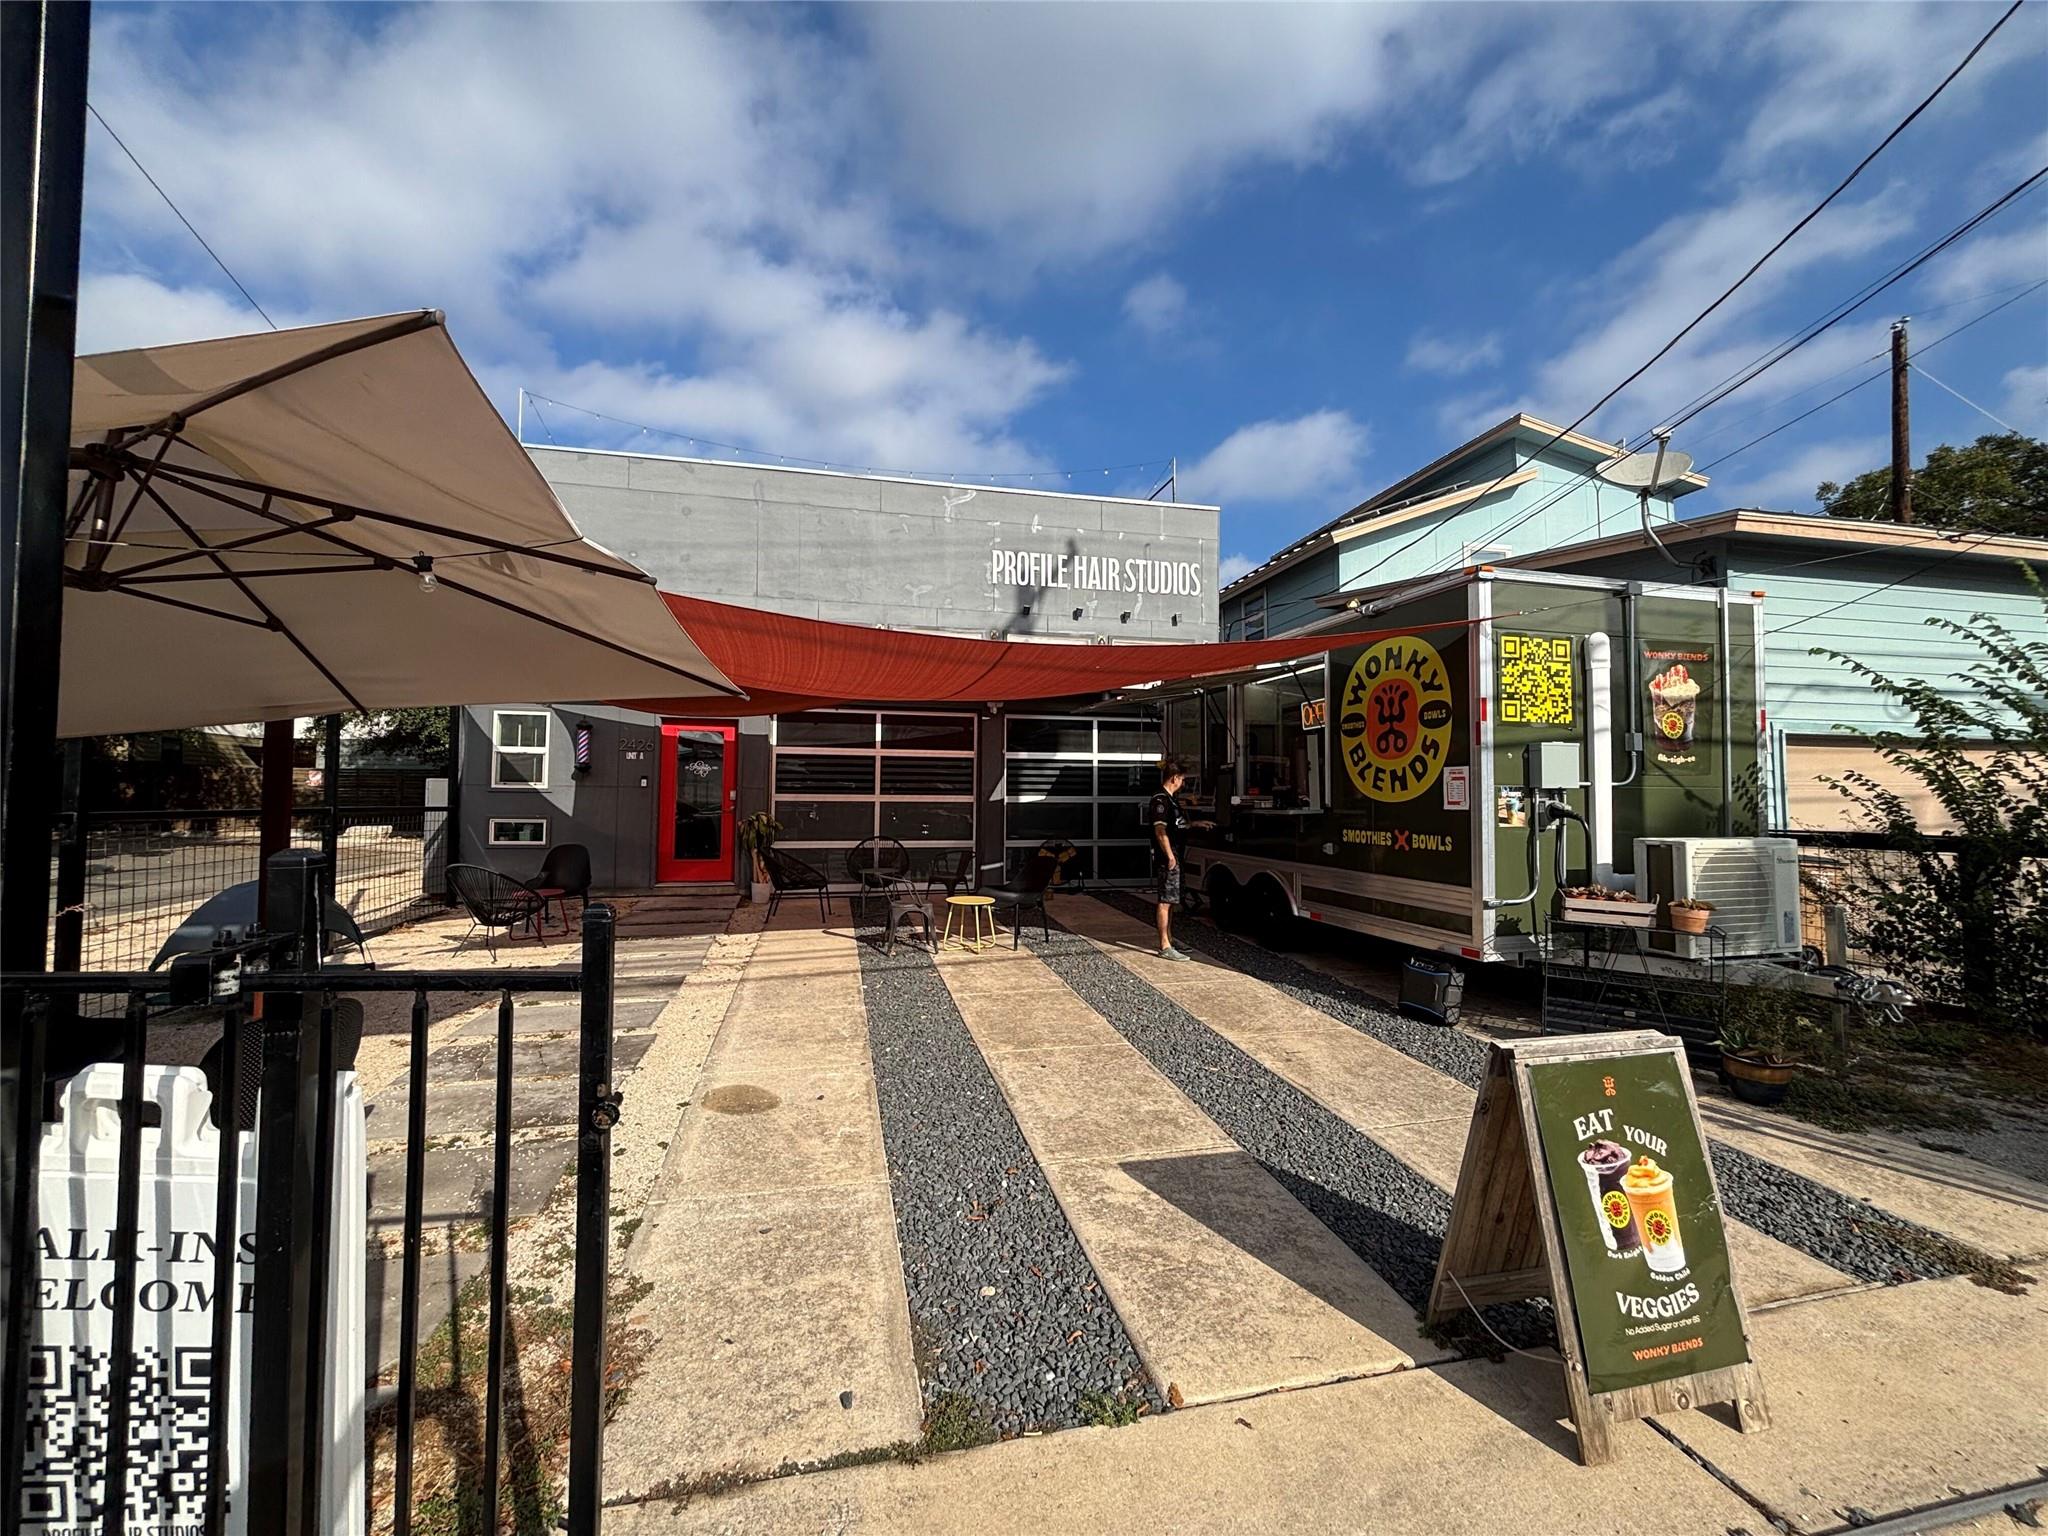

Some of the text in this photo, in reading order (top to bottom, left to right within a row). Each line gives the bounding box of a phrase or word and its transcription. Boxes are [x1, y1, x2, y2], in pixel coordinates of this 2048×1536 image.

[992, 550, 1201, 597] PROFILE HAIR STUDIOS
[1643, 650, 1709, 661] WONKY BLENDS
[1346, 645, 1444, 706] WONKY
[618, 738, 655, 751] 2426
[626, 752, 644, 760] UNIT A
[1348, 734, 1441, 794] BLENDS
[1342, 829, 1392, 846] SMOOTHIES
[1412, 833, 1453, 852] BOWLS
[1573, 1108, 1614, 1141] EAT
[1622, 1124, 1668, 1157] YOUR
[1650, 1267, 1691, 1282] Golden Child
[1616, 1282, 1700, 1319] VEGGIES
[1625, 1327, 1635, 1336] No
[1635, 1325, 1655, 1334] Added
[1654, 1322, 1673, 1332] Sugar
[1679, 1317, 1692, 1327] other
[1632, 1337, 1704, 1361] WONKY BLENDS
